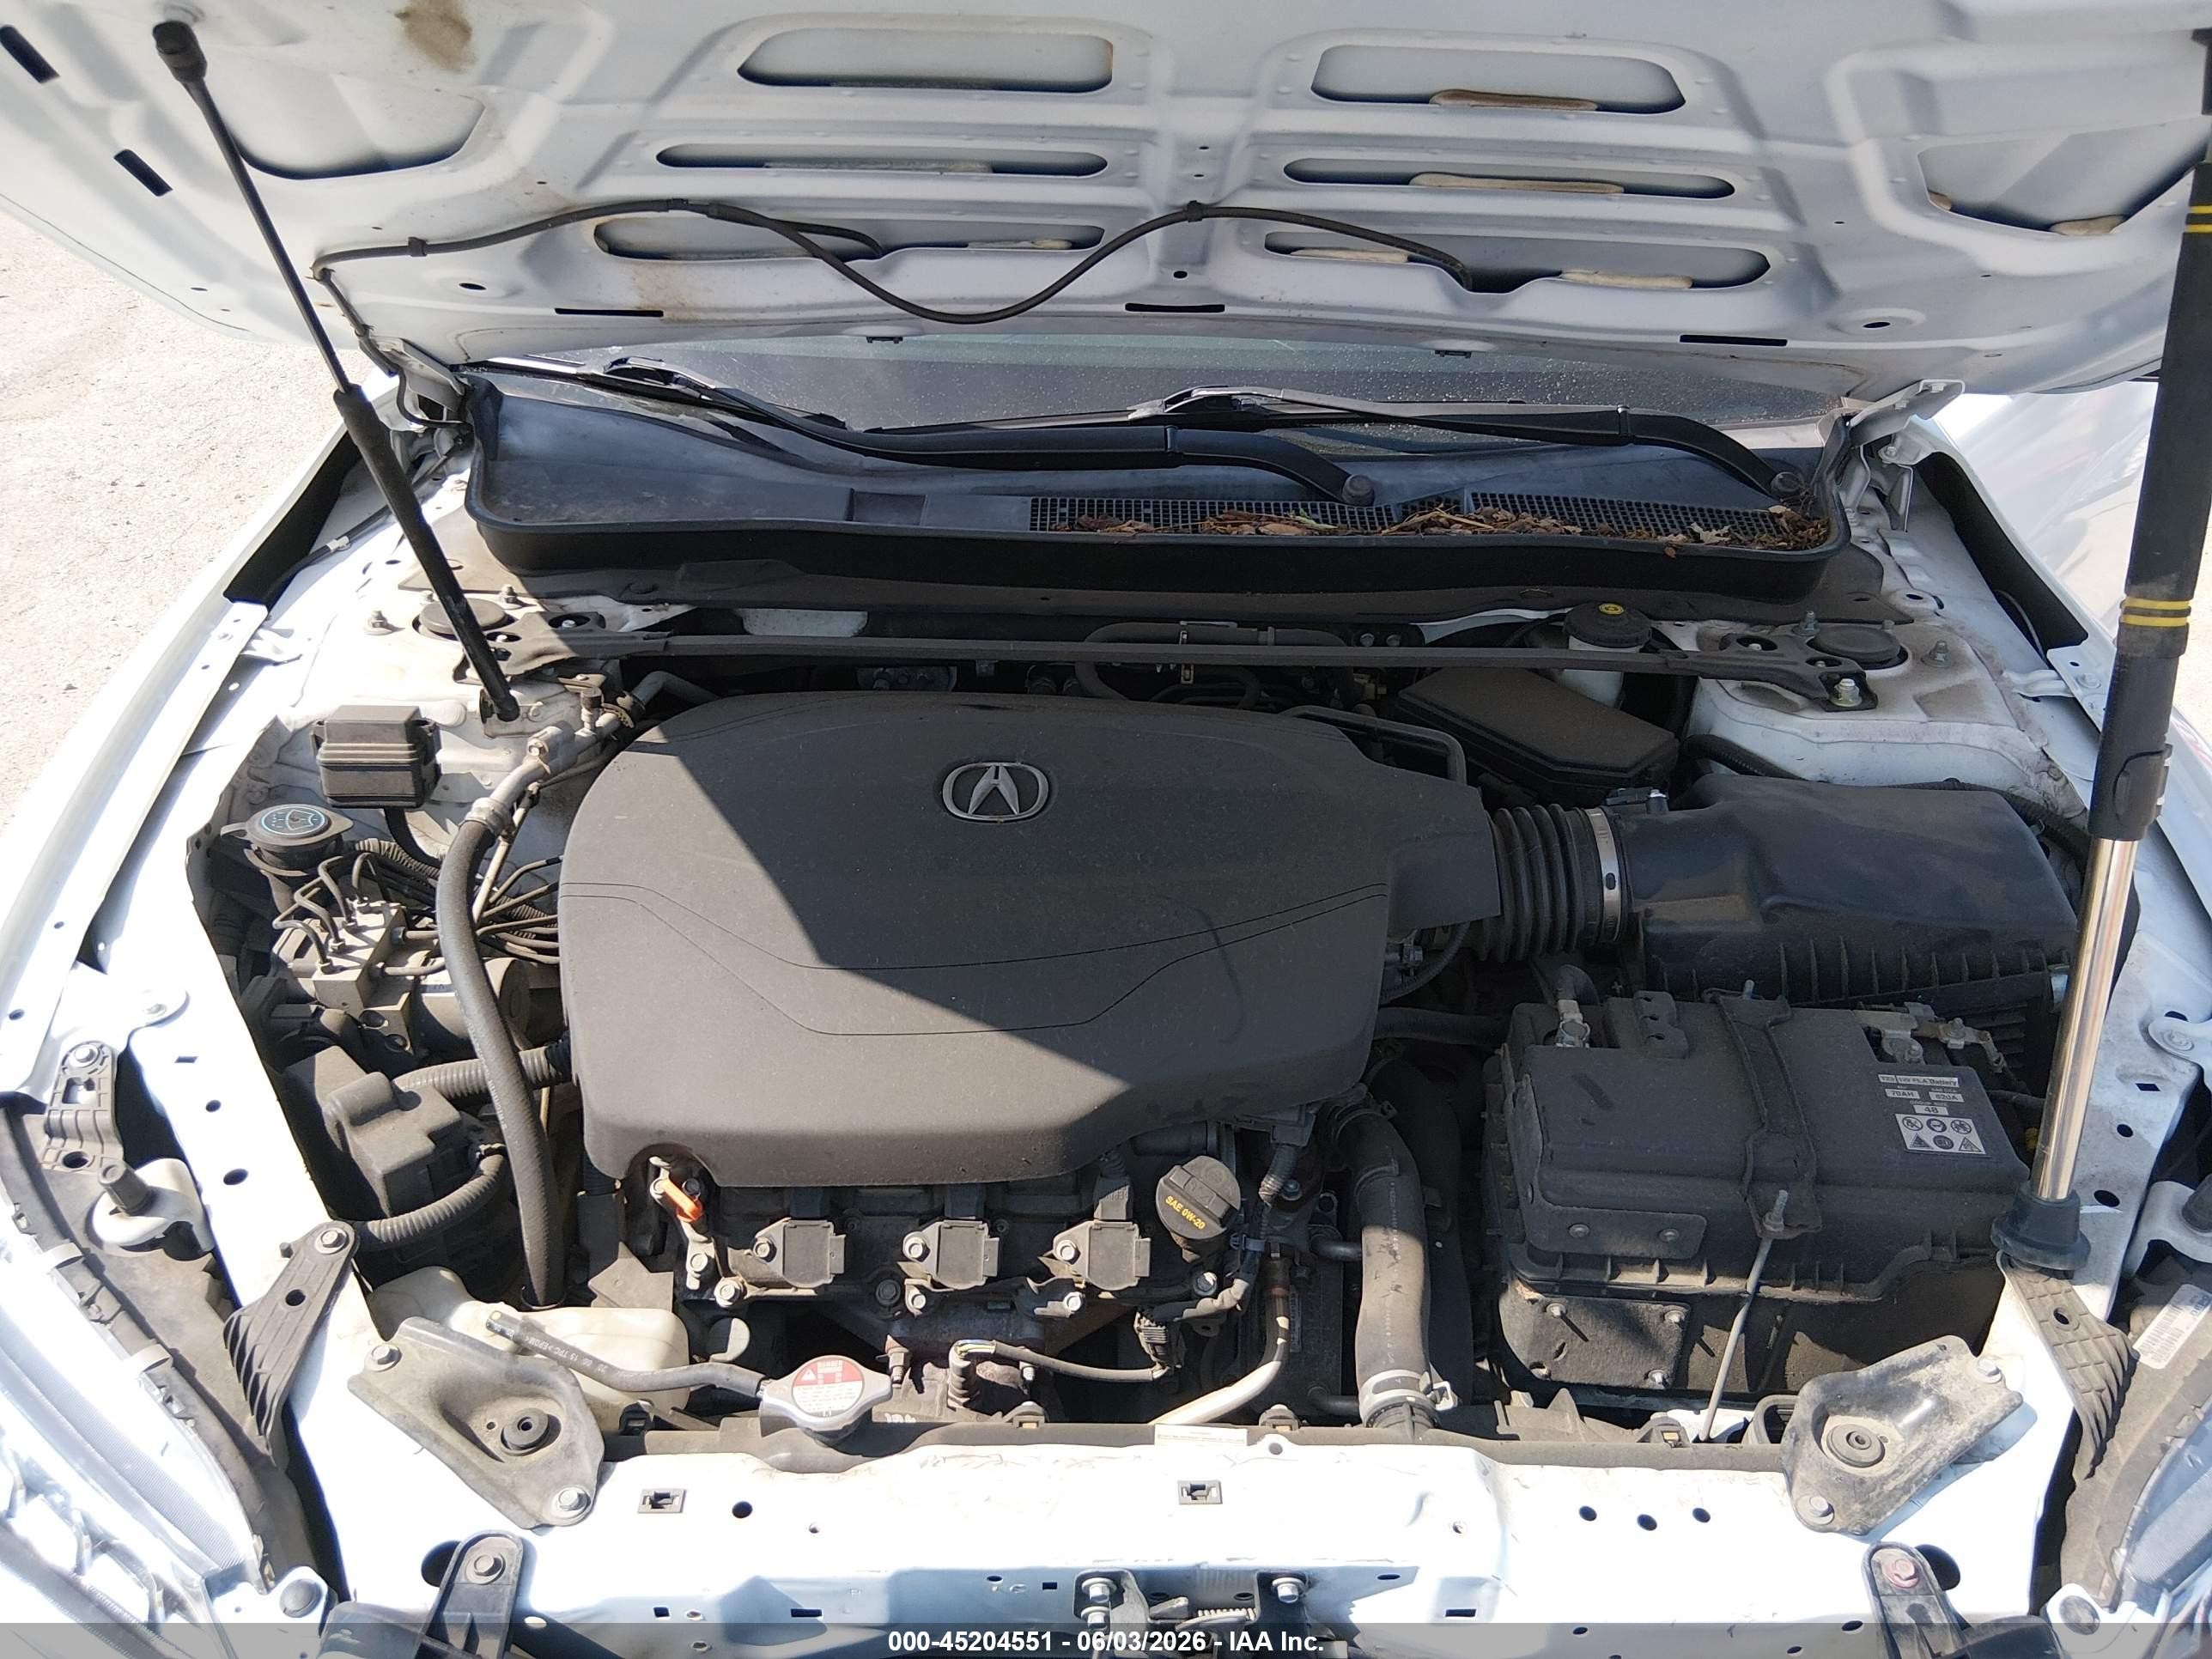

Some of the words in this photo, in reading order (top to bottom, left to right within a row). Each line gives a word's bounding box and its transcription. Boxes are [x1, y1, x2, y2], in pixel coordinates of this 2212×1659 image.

[1928, 1078, 1957, 1086] Battery
[1165, 1195, 1183, 1212] SAE
[1182, 1208, 1206, 1230] 0W-20
